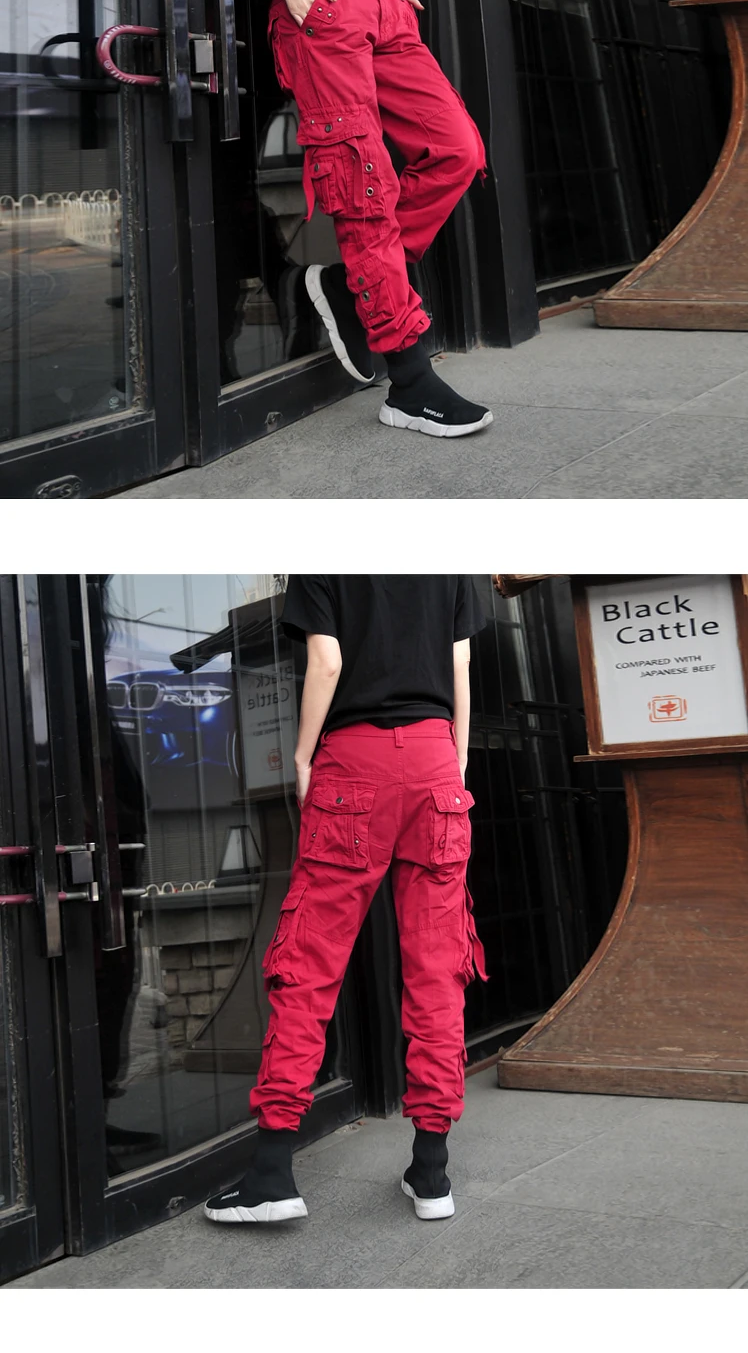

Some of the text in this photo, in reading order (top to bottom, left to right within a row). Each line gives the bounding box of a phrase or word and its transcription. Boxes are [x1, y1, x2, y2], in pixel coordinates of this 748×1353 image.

[602, 595, 693, 622] Black
[616, 618, 720, 644] Cattle
[615, 655, 702, 670] COMPARED WITH
[640, 664, 716, 678] JAPANESE BEEF
